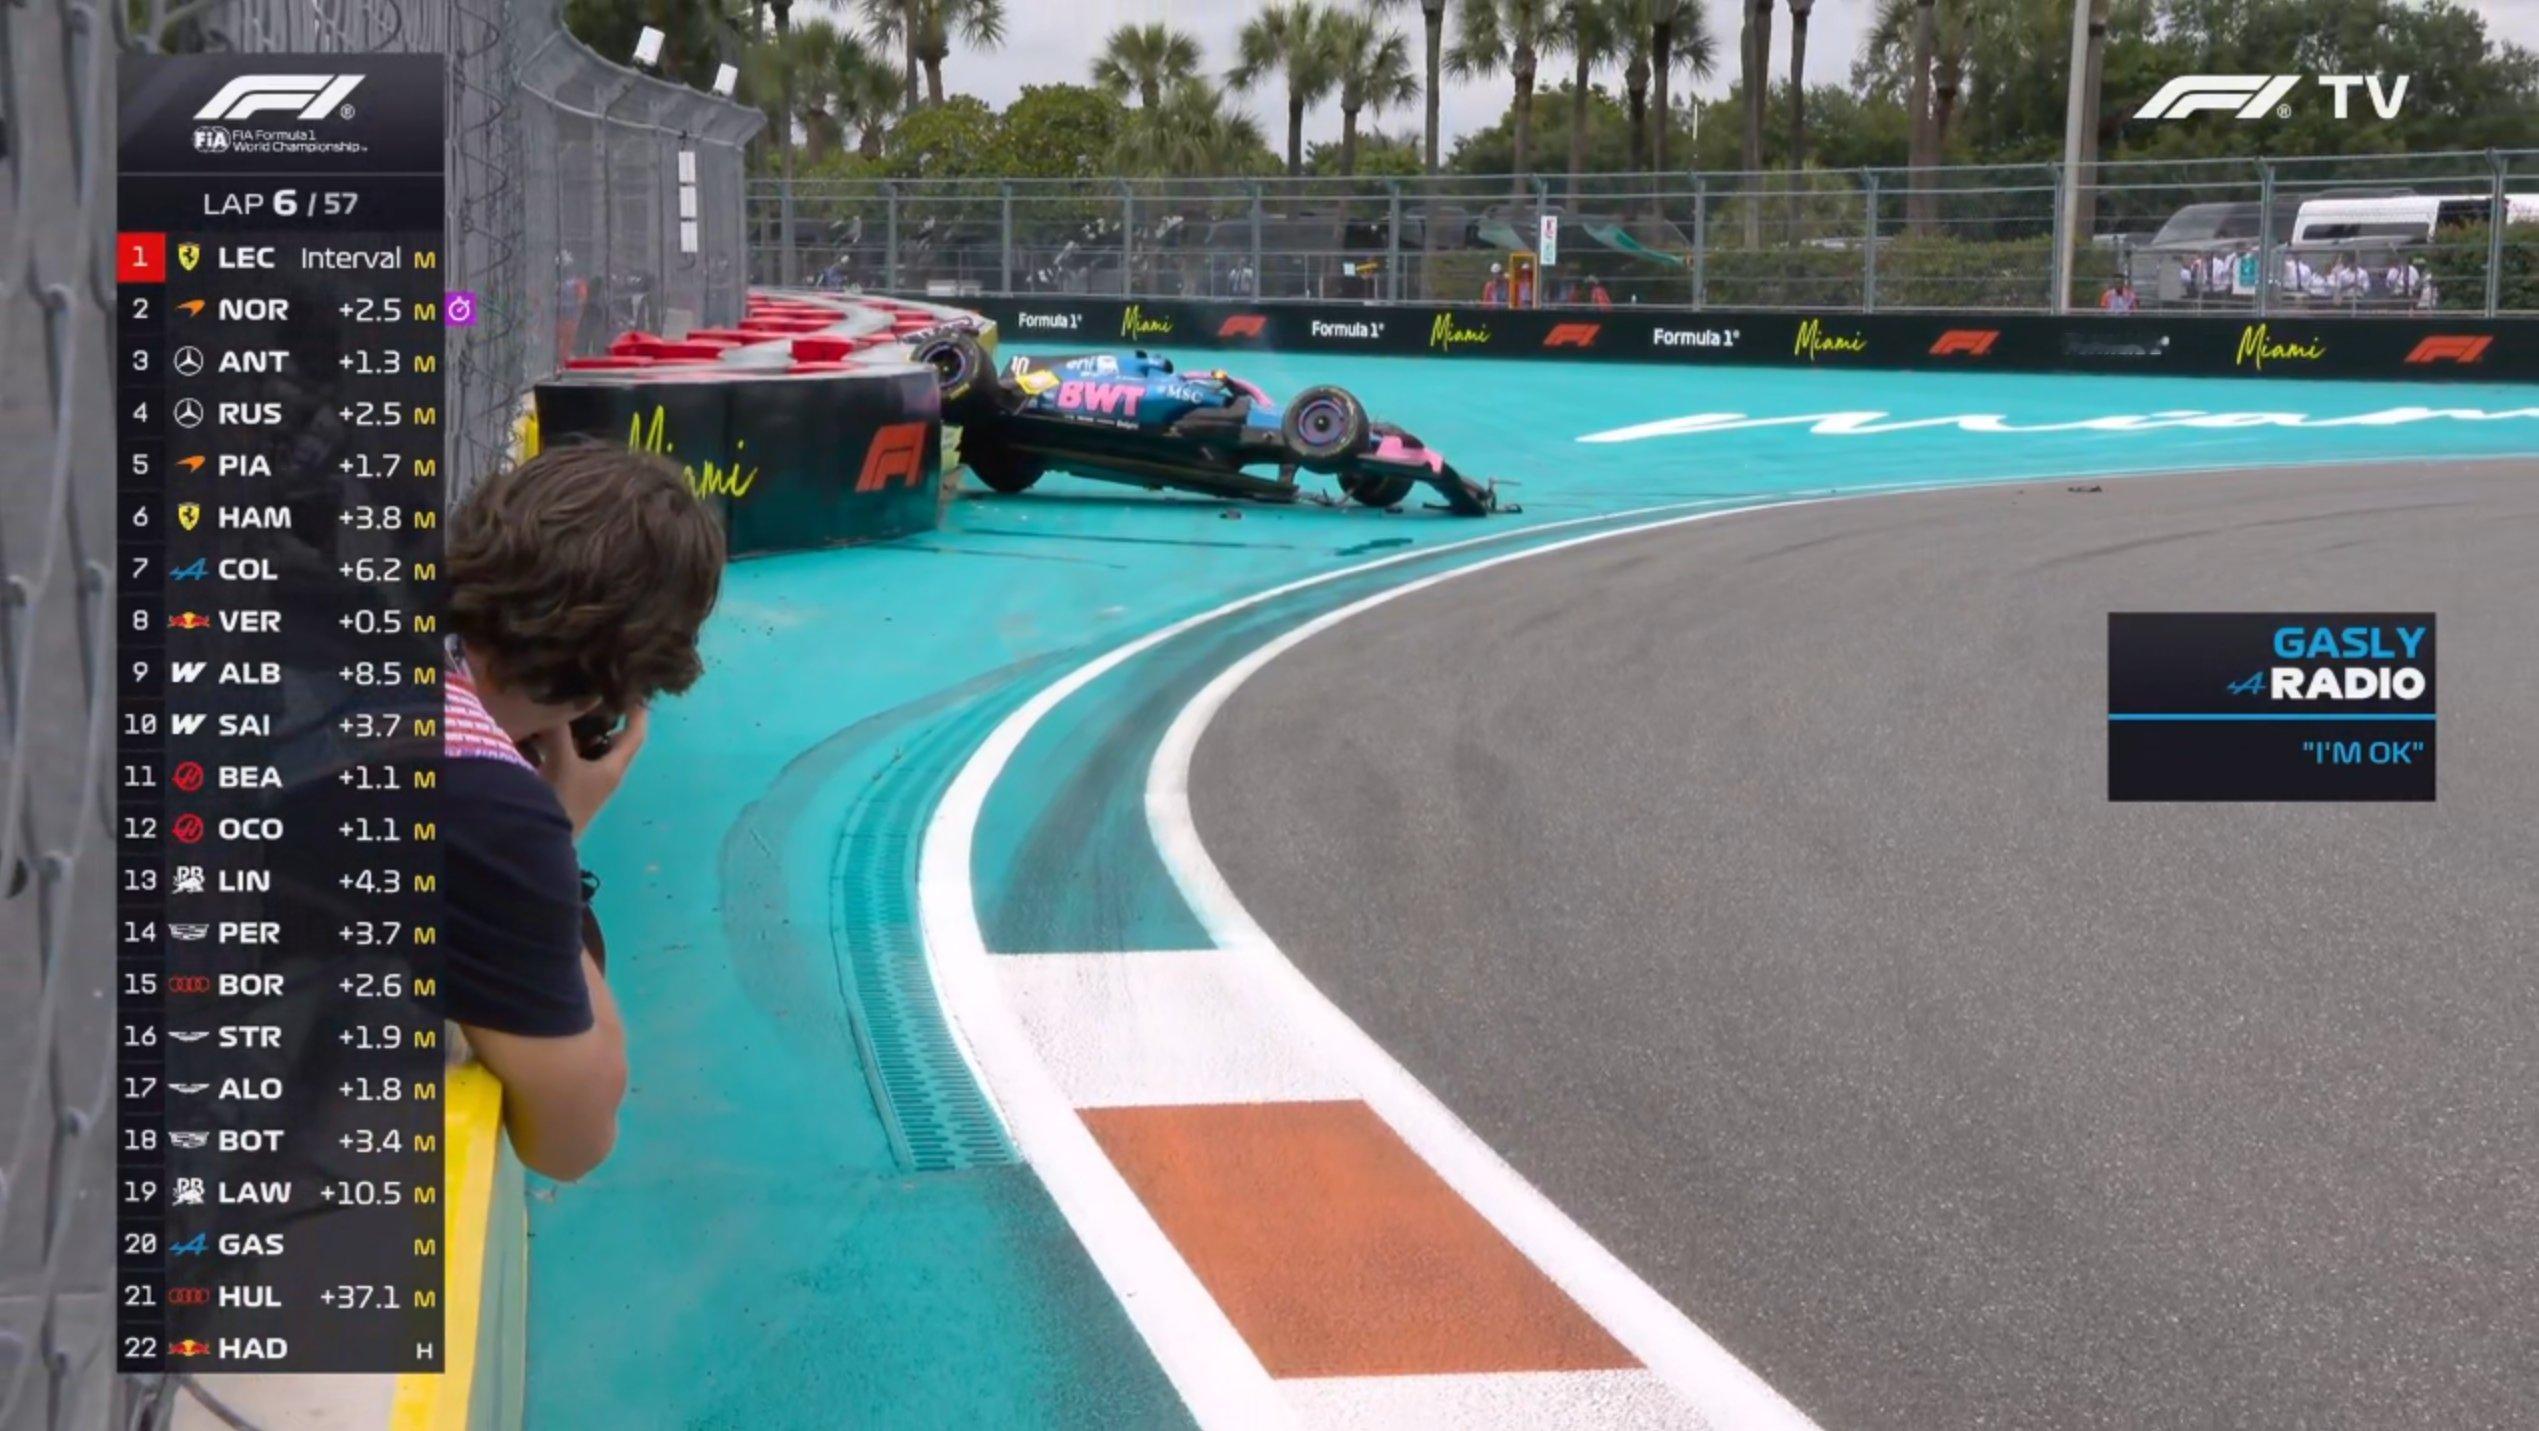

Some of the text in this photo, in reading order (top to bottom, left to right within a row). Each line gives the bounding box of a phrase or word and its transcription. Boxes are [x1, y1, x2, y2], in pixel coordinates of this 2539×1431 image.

[1018, 311, 1068, 329] Formula
[1120, 305, 1174, 340] Miami
[1312, 320, 1367, 337] Formula
[1430, 313, 1492, 351] Miami
[1653, 327, 1720, 346] Formula
[1794, 318, 1868, 361] Miami
[2235, 322, 2327, 371] Miami
[1056, 379, 1147, 418] BWT
